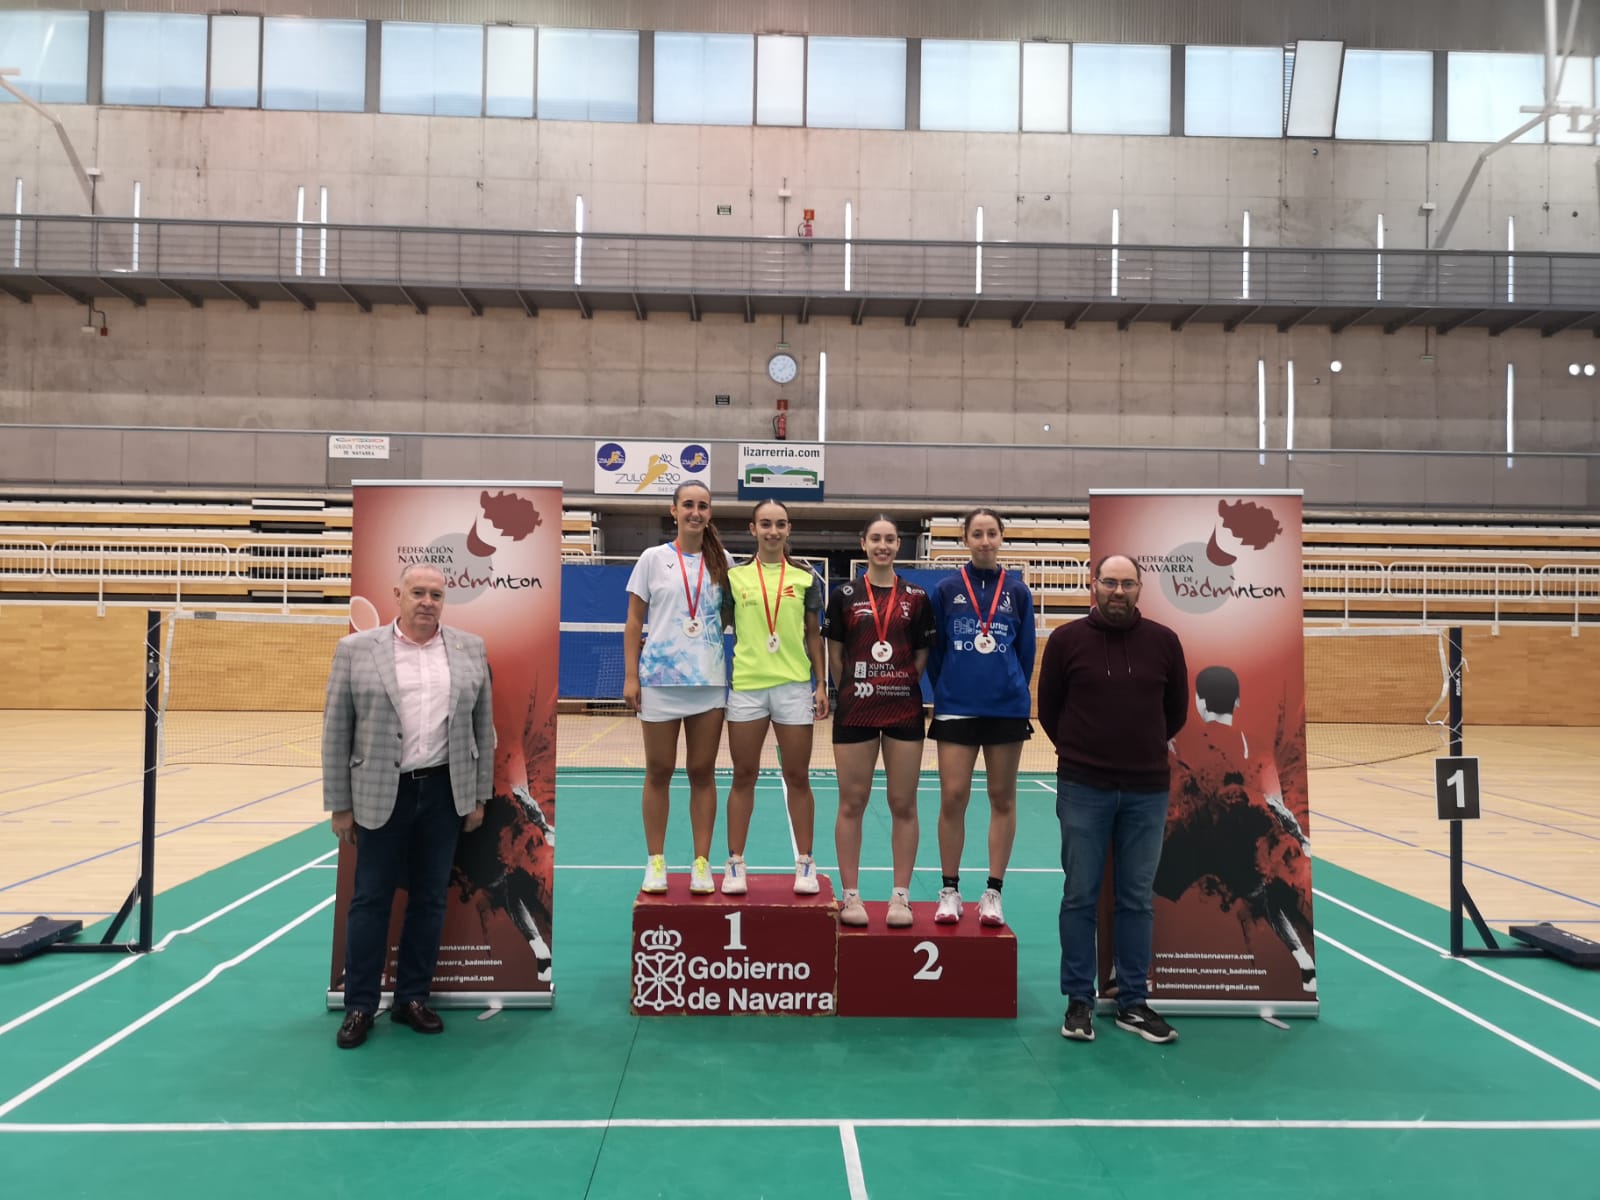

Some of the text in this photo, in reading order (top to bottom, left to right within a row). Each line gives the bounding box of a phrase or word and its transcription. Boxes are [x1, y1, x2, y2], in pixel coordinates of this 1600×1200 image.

[743, 446, 820, 457] lizarrerria.com
[397, 545, 454, 554] FEDERACIÓN
[398, 555, 454, 564] NAVARRA
[1137, 554, 1194, 563] FEDERACIÓN
[1138, 564, 1194, 573] NAVARRA
[868, 663, 895, 671] XUNTA
[868, 670, 910, 679] DE GALICIA
[1446, 769, 1466, 808] 1
[723, 911, 748, 950] 1
[913, 940, 943, 980] 2
[1155, 952, 1255, 960] www.badmintonnavarra.com
[688, 956, 811, 980] Gobierno
[1156, 982, 1260, 992] badmintonnavarra@gmail.com
[687, 986, 834, 1011] de Navarra
